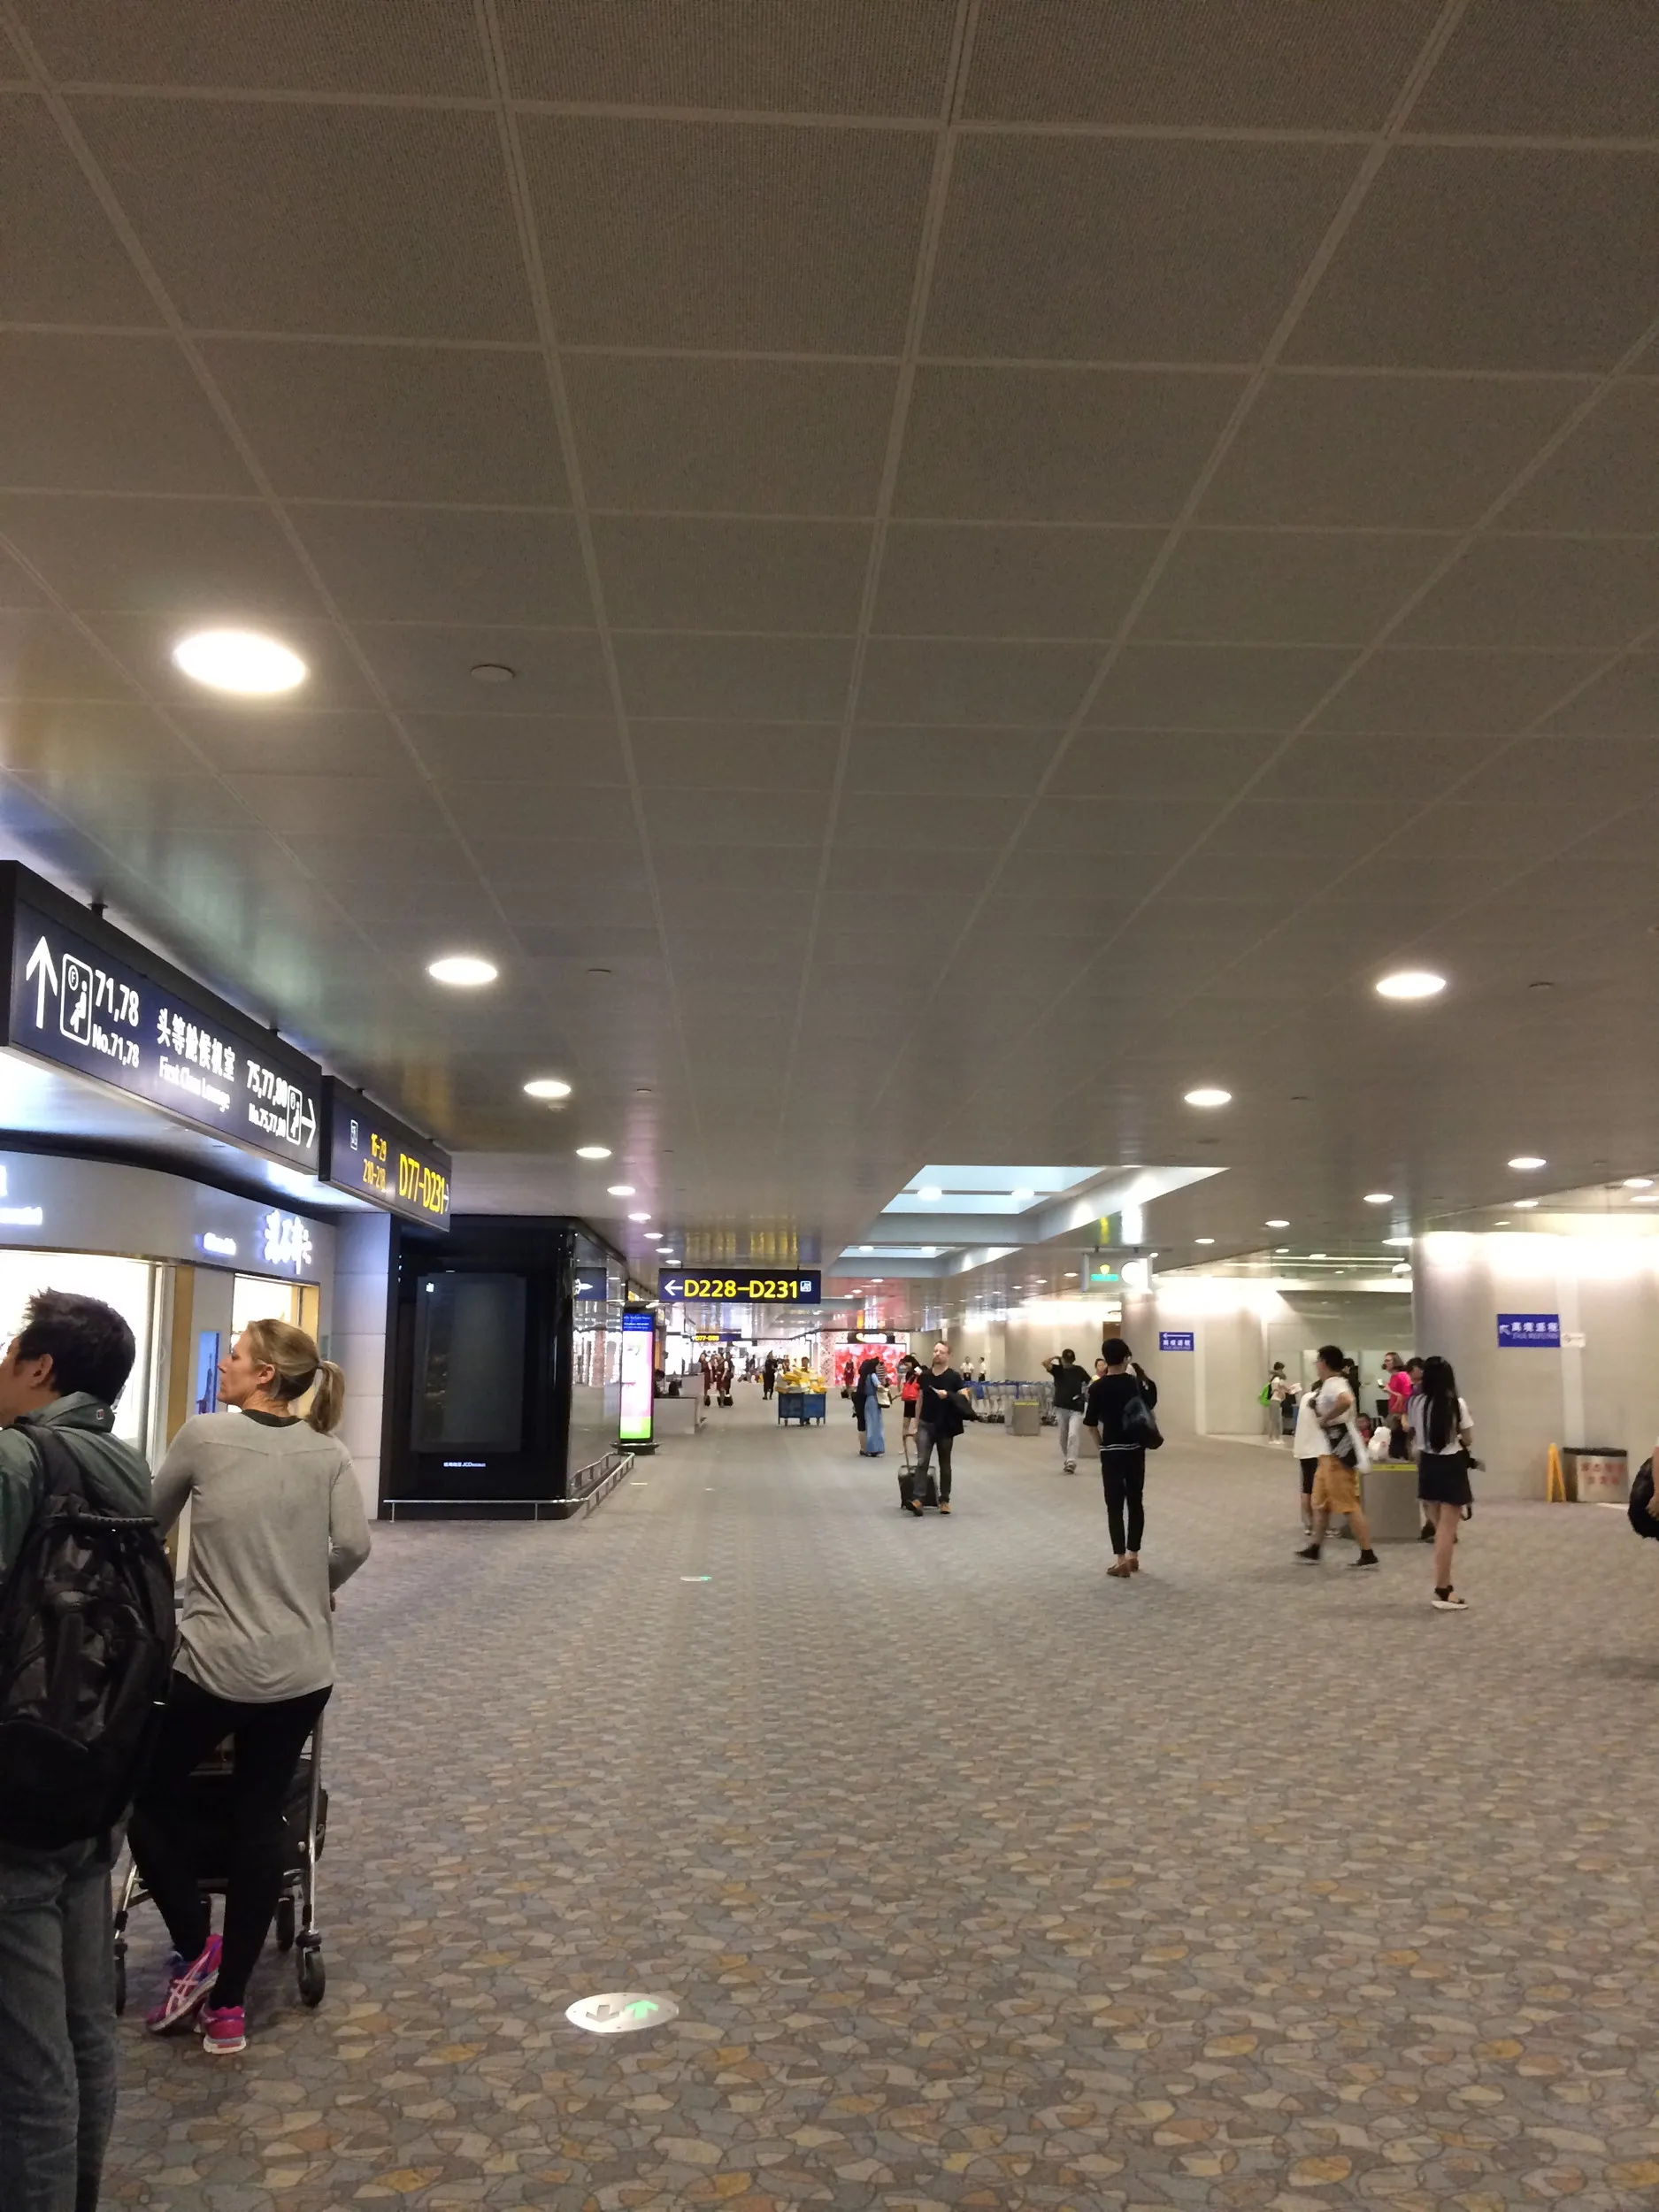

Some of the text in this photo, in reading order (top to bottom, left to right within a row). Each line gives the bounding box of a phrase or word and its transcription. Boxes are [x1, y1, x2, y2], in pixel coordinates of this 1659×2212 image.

[95, 969, 139, 1026] 71,78
[92, 1024, 140, 1068] No.71,78
[684, 1279, 798, 1298] D228-D231
